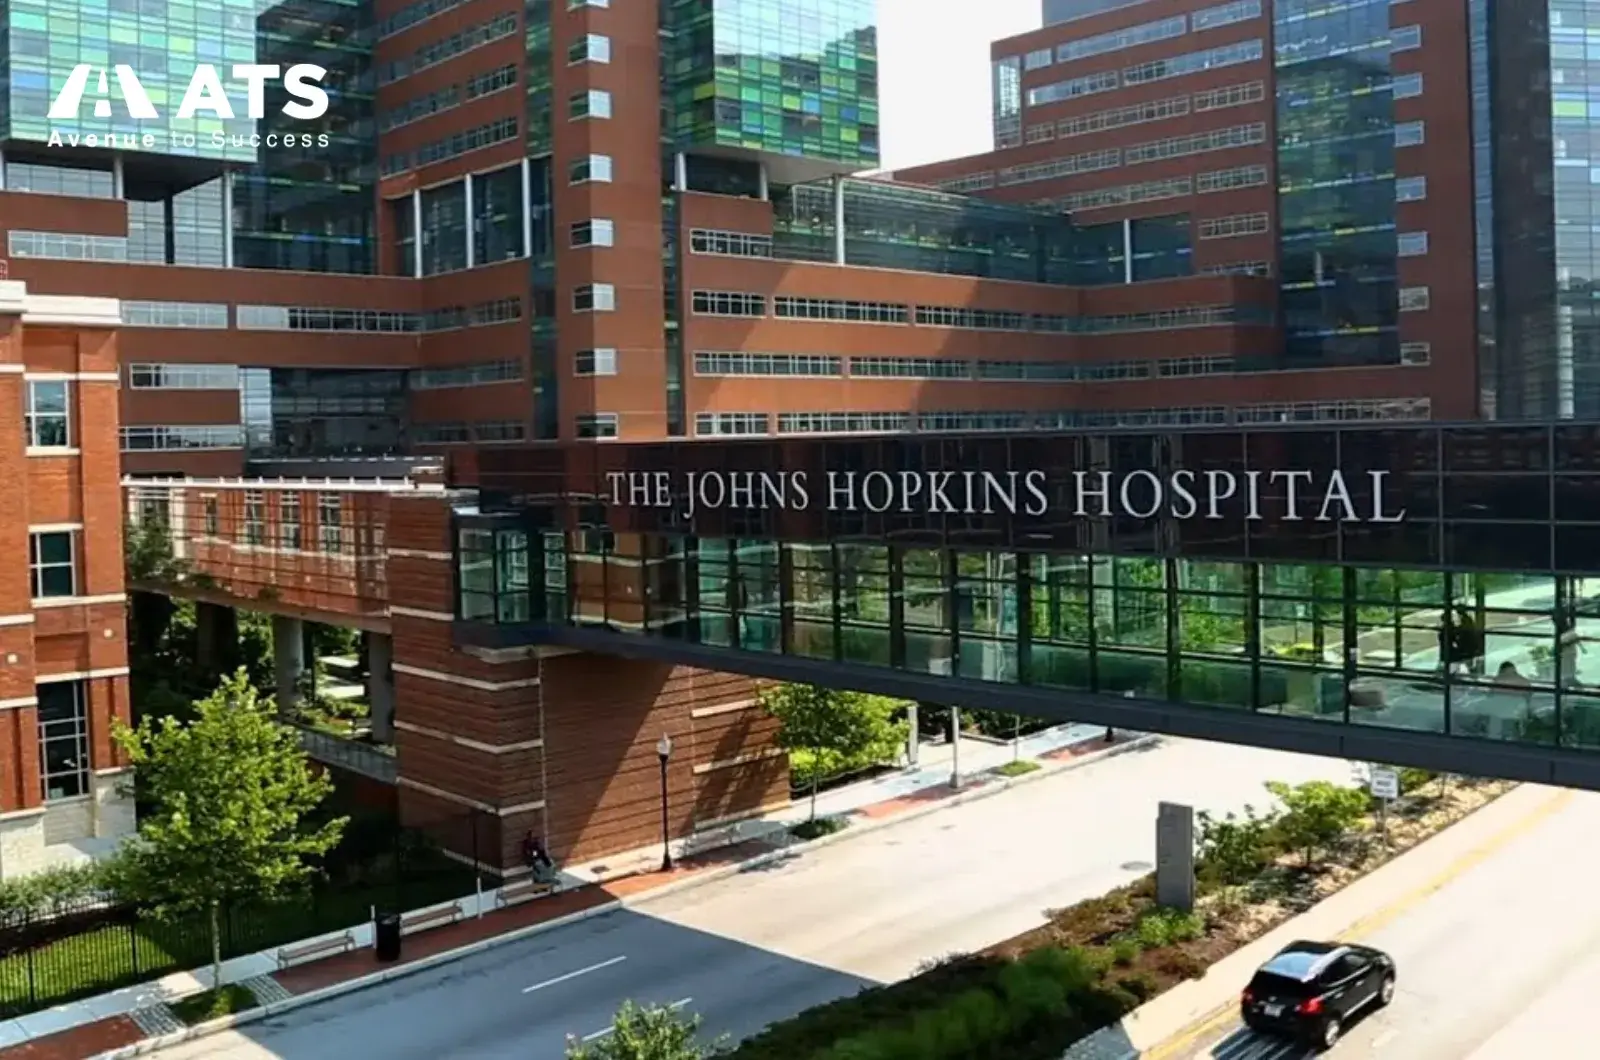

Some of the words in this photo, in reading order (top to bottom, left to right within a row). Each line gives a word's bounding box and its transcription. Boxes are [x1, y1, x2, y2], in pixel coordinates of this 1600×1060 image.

[605, 471, 673, 507] THE
[683, 470, 810, 519] JOHNS
[826, 469, 1049, 517] HOPKINS
[1072, 468, 1406, 523] HOSPITAL
